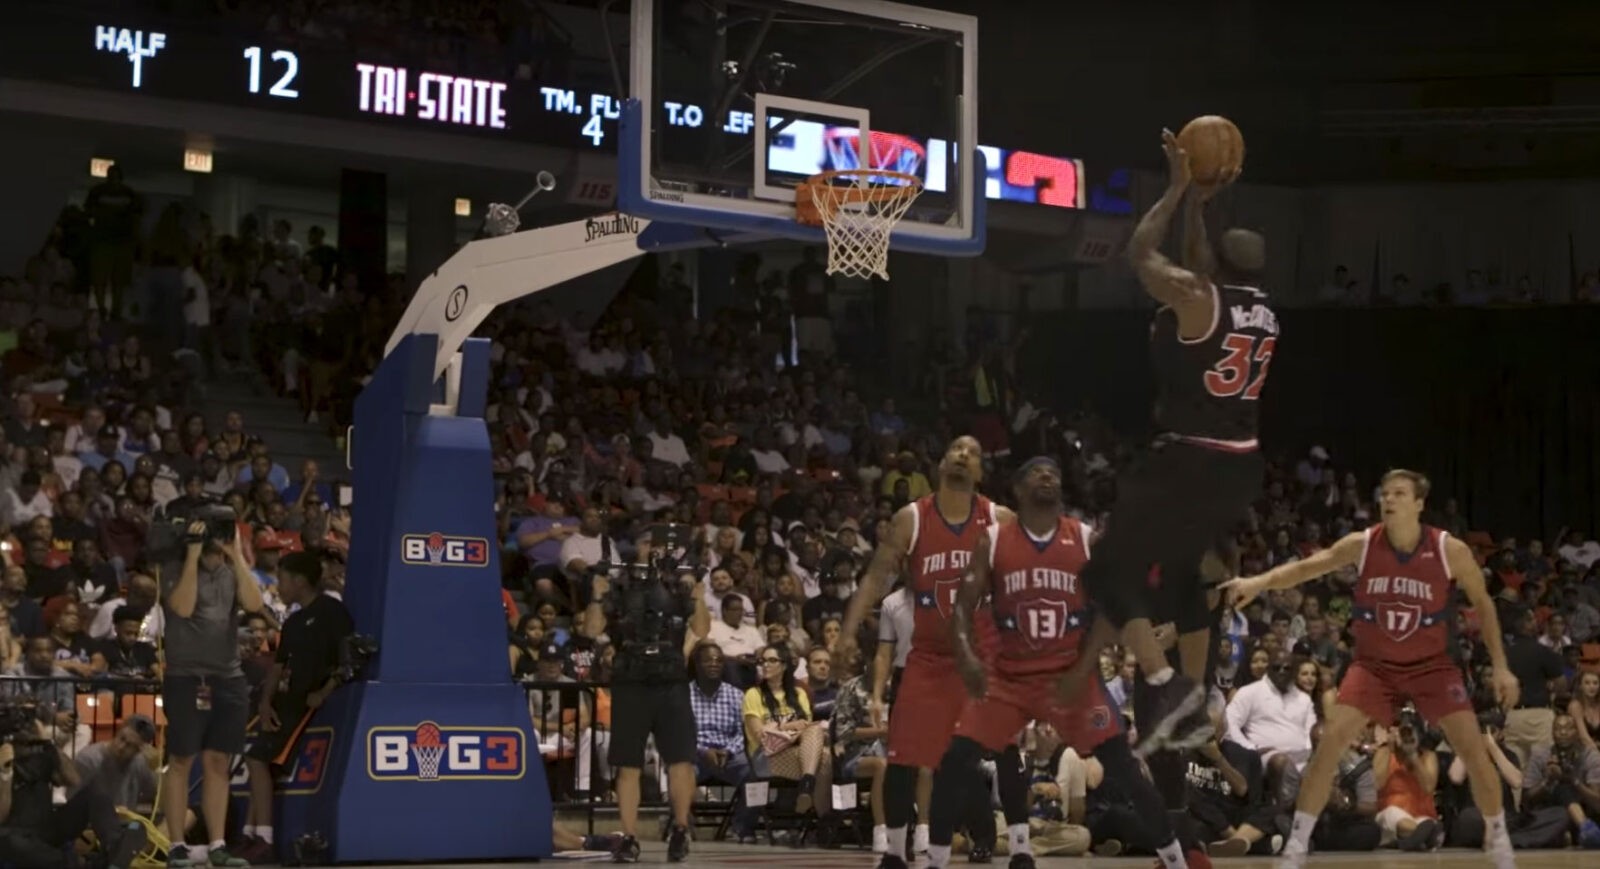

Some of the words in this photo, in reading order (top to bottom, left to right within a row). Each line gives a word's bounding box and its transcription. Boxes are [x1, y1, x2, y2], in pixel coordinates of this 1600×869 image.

[96, 25, 166, 57] HALF
[127, 51, 142, 88] 1
[244, 46, 299, 98] 12
[581, 114, 605, 147] 4
[585, 214, 639, 242] SPALDING
[1203, 333, 1277, 400] 32
[922, 551, 947, 575] TRI
[1004, 571, 1027, 595] TRI
[1032, 567, 1078, 595] STATE
[1366, 576, 1391, 595] TRI
[1392, 576, 1434, 601] STATE
[1027, 608, 1057, 639] 13
[1386, 610, 1412, 631] 17
